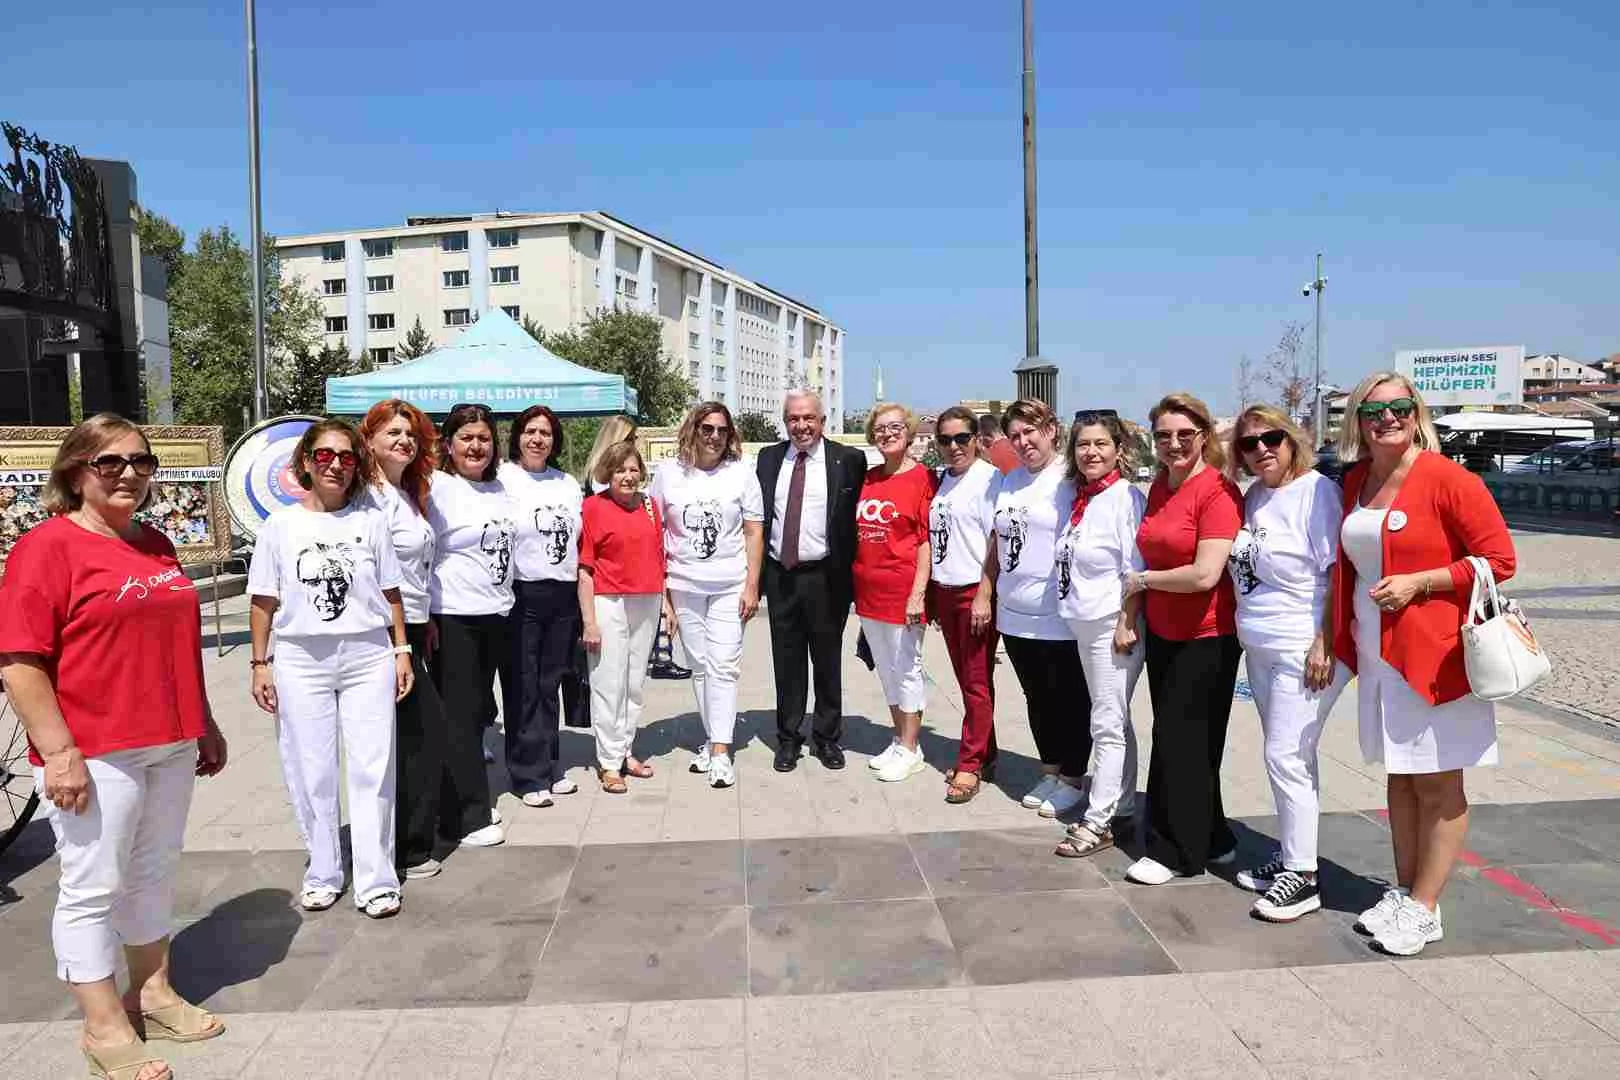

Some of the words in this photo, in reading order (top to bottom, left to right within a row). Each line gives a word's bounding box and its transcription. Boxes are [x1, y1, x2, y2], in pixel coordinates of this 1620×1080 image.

[1414, 352, 1469, 364] HERKESİN
[1472, 352, 1497, 362] SESİ
[1414, 363, 1497, 378] HEPİMİZİN
